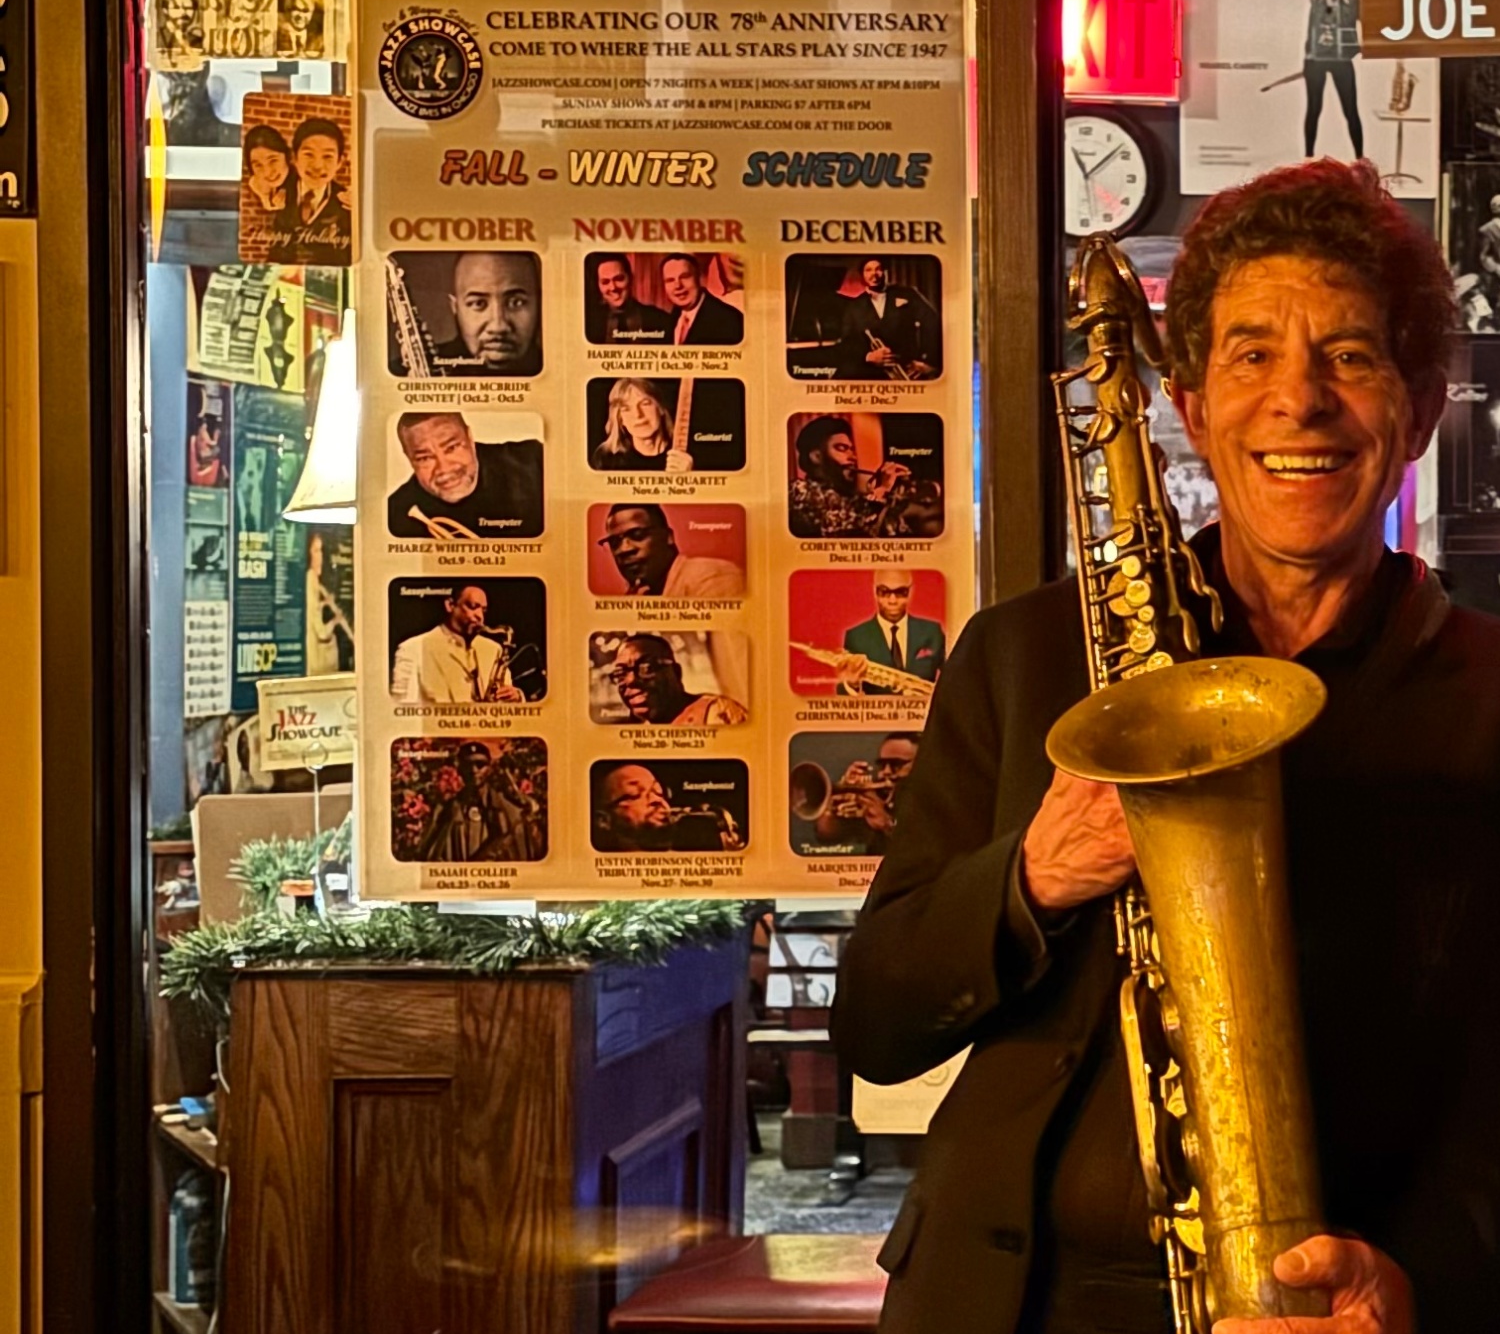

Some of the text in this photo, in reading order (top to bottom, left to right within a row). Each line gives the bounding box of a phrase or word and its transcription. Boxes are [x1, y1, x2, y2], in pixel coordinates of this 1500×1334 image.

[486, 11, 658, 30] CELEBRATING
[665, 12, 719, 31] OUR
[730, 11, 767, 31] 78th
[771, 12, 949, 33] ANNIVERSARY
[380, 30, 407, 68] JAZZ
[408, 19, 481, 69] SHOWCASE
[489, 41, 947, 58] COME TO WHERE THE ALL STARS PLAY SINCE 1947
[492, 78, 611, 89] JAZZSHOWCASE.COM
[620, 78, 651, 89] OPEN
[653, 78, 659, 88] 7
[662, 78, 706, 89] NIGHTS
[708, 79, 717, 89] A
[720, 79, 753, 89] WEEK
[761, 79, 814, 90] MON-SAT
[817, 79, 858, 90] SHOWS
[861, 79, 875, 90] AT
[562, 98, 608, 110] SUNDAY
[611, 98, 652, 109] SHOWS
[656, 99, 669, 109] AT
[672, 99, 695, 109] 4PM
[740, 99, 792, 110] PARKING
[794, 99, 806, 110] $7
[809, 100, 845, 110] AFTER
[541, 119, 892, 131] PURCHASE TICKETS AT JAZZSHOWCASE.COM OR AT THE DOOR
[1120, 150, 1131, 161] 2
[439, 149, 932, 188] FALL WINTER SCHEDULE
[1126, 174, 1137, 184] 3
[1120, 197, 1130, 206] 4
[389, 217, 536, 242] OCTOBER
[574, 218, 746, 244] NOVEMBER
[780, 219, 946, 244] DECEMBER
[587, 350, 742, 360] HARRY ALLEN ANDY BROWN
[601, 361, 653, 371] QUARTET
[397, 382, 531, 392] CHRISTOPHER MCBRIDE
[806, 384, 925, 394] JEREMY PELT QUINTET
[404, 393, 455, 403] QUINTET
[889, 446, 932, 457] Trumpeter
[607, 476, 727, 486] MIKE STERN QUARTET
[388, 543, 542, 554] PHAREZ WHITTED QUINTET
[800, 542, 932, 553] COREY WILKES QUARTET
[595, 600, 742, 611] KEYON HARROLD QUINTET
[807, 700, 927, 710] TIM JAZZY
[394, 707, 542, 718] CHICO FREEMAN QUARTET
[795, 711, 859, 721] CHRISTMAS
[620, 729, 717, 739] CYRUS CHESTNUT
[595, 856, 745, 867] JUSTIN ROBINSON QUINTET
[429, 867, 517, 877] ISAIAH COLLIER
[597, 867, 743, 877] TRIBUTE TO ROY HARGROVE
